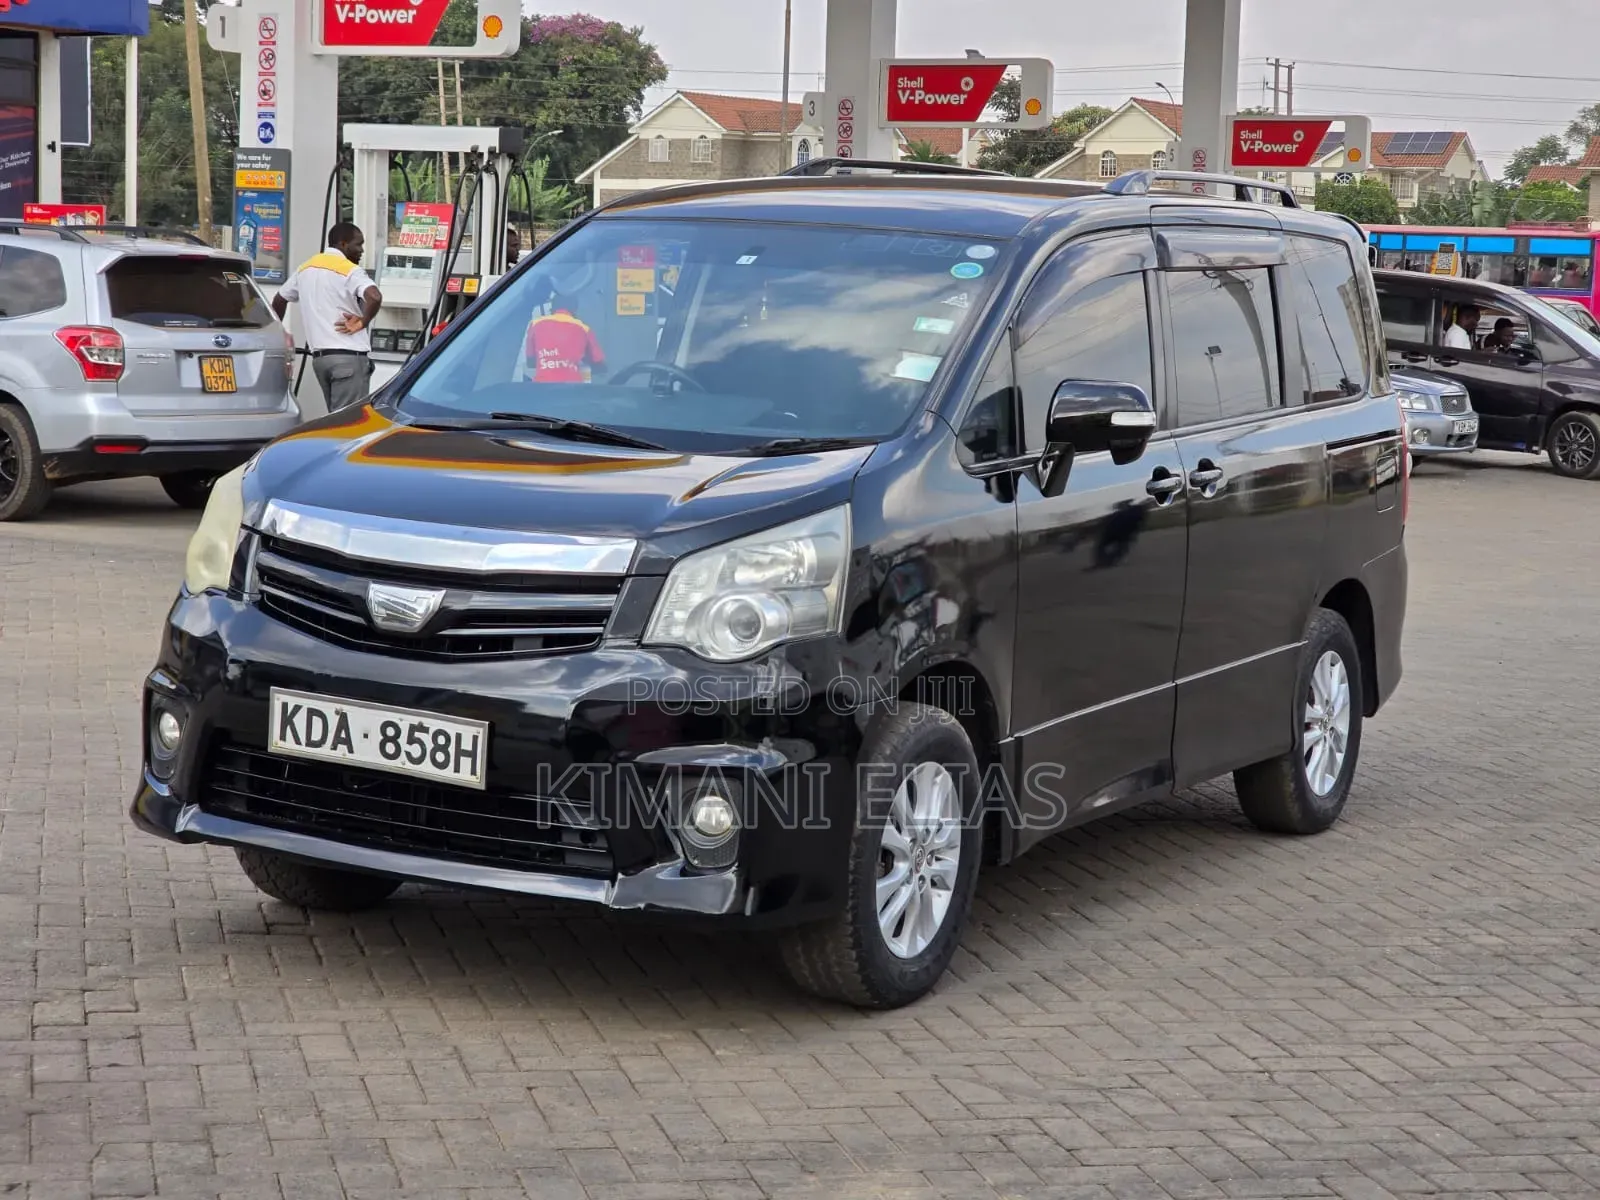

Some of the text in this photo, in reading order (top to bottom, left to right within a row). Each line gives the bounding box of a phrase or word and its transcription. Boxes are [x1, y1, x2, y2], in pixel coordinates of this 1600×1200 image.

[335, 4, 417, 24] V-Power
[219, 15, 226, 39] 1
[897, 77, 924, 89] Shell
[897, 90, 968, 105] V-Power
[808, 100, 816, 117] 3
[1240, 130, 1263, 140] Shell
[1240, 141, 1299, 153] V-Power
[209, 357, 232, 374] KDH
[279, 701, 480, 777] KDA 858H
